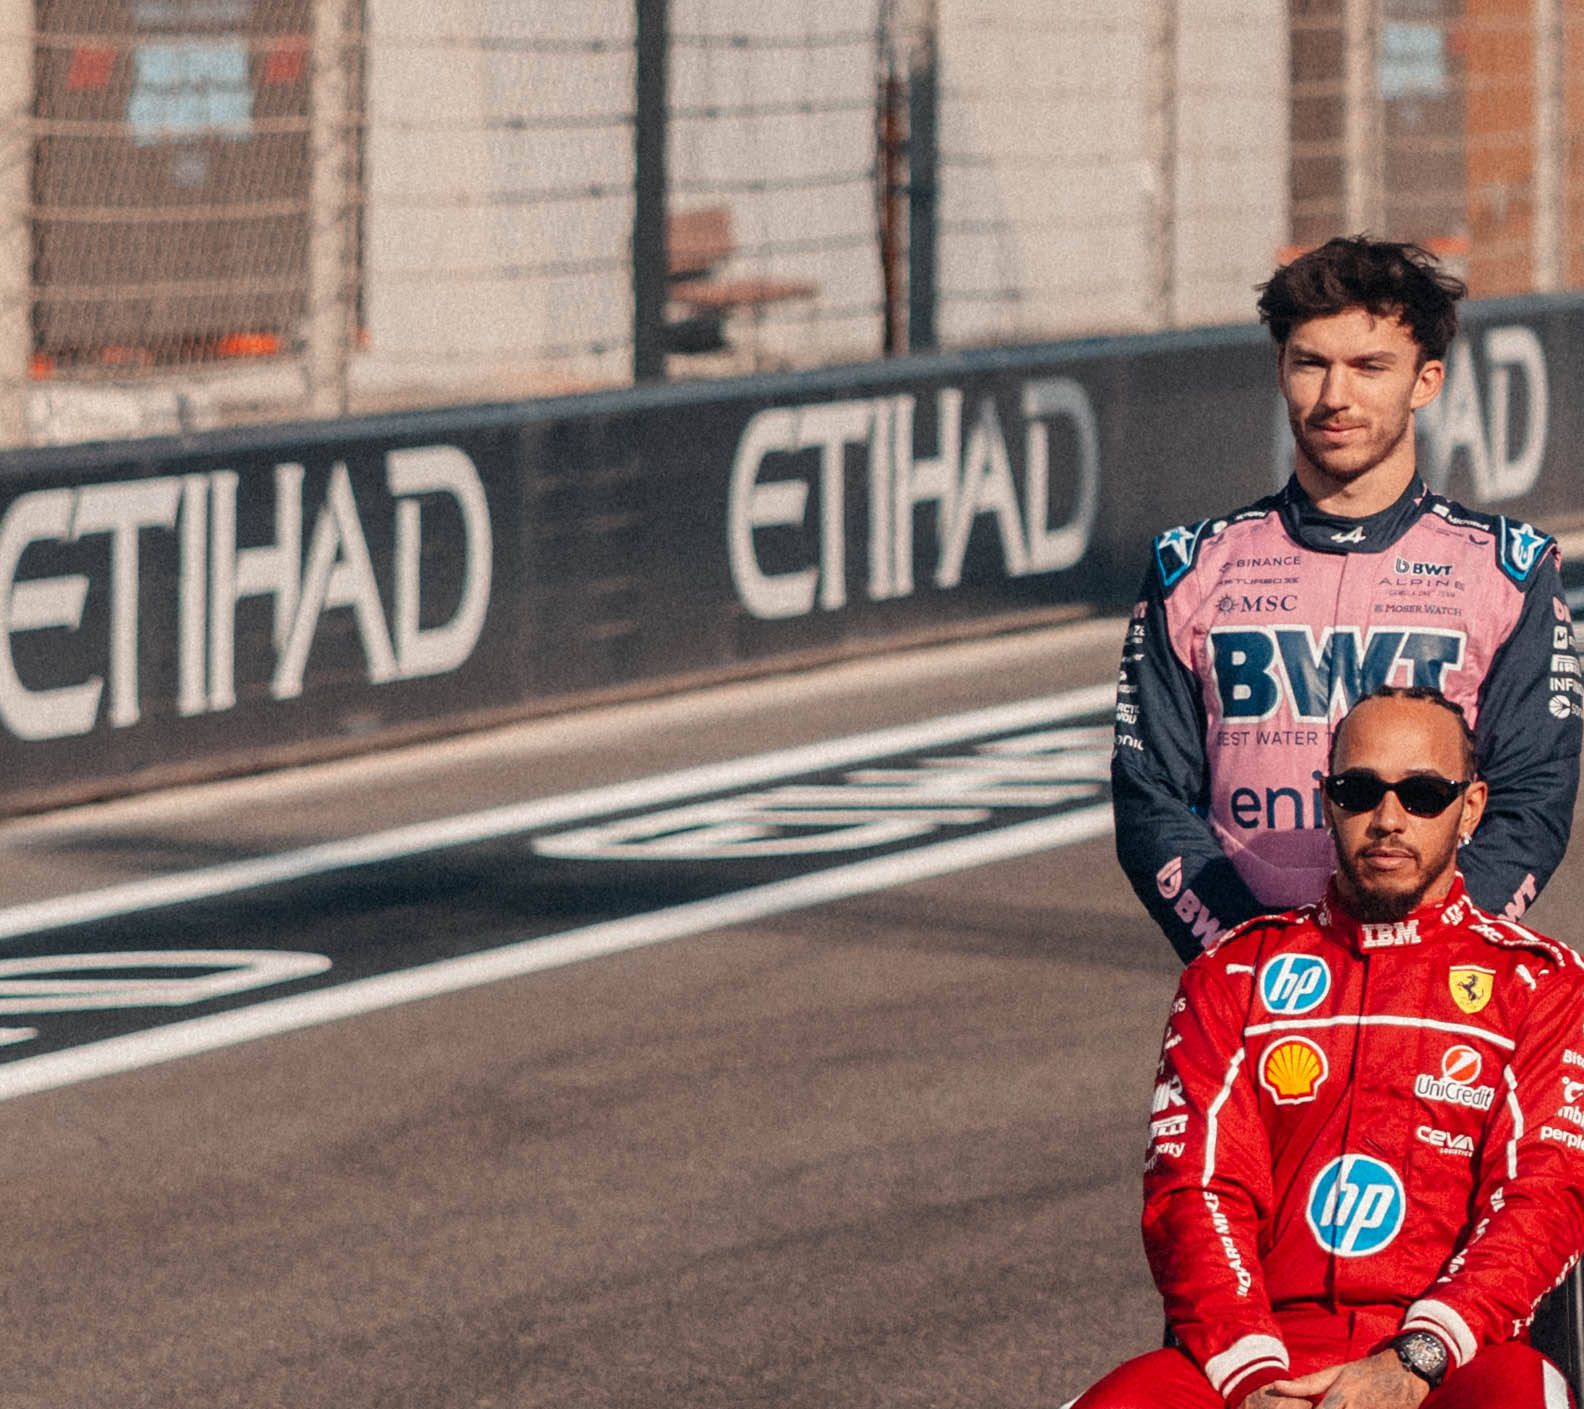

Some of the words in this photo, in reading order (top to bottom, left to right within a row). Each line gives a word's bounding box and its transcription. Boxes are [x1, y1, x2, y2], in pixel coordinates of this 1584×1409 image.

[727, 378, 1098, 620] ETIHAD
[1236, 555, 1301, 568] BINANCE
[1412, 562, 1452, 576] BWT
[0, 442, 492, 741] ETIHAD
[1380, 579, 1465, 591] ALPINE
[1241, 595, 1298, 613] MSC
[1210, 625, 1467, 723] BWT
[1362, 920, 1421, 948] IBM
[1271, 955, 1318, 1013] hp
[1418, 1078, 1494, 1108] UniCredit
[1322, 1156, 1391, 1256] hp
